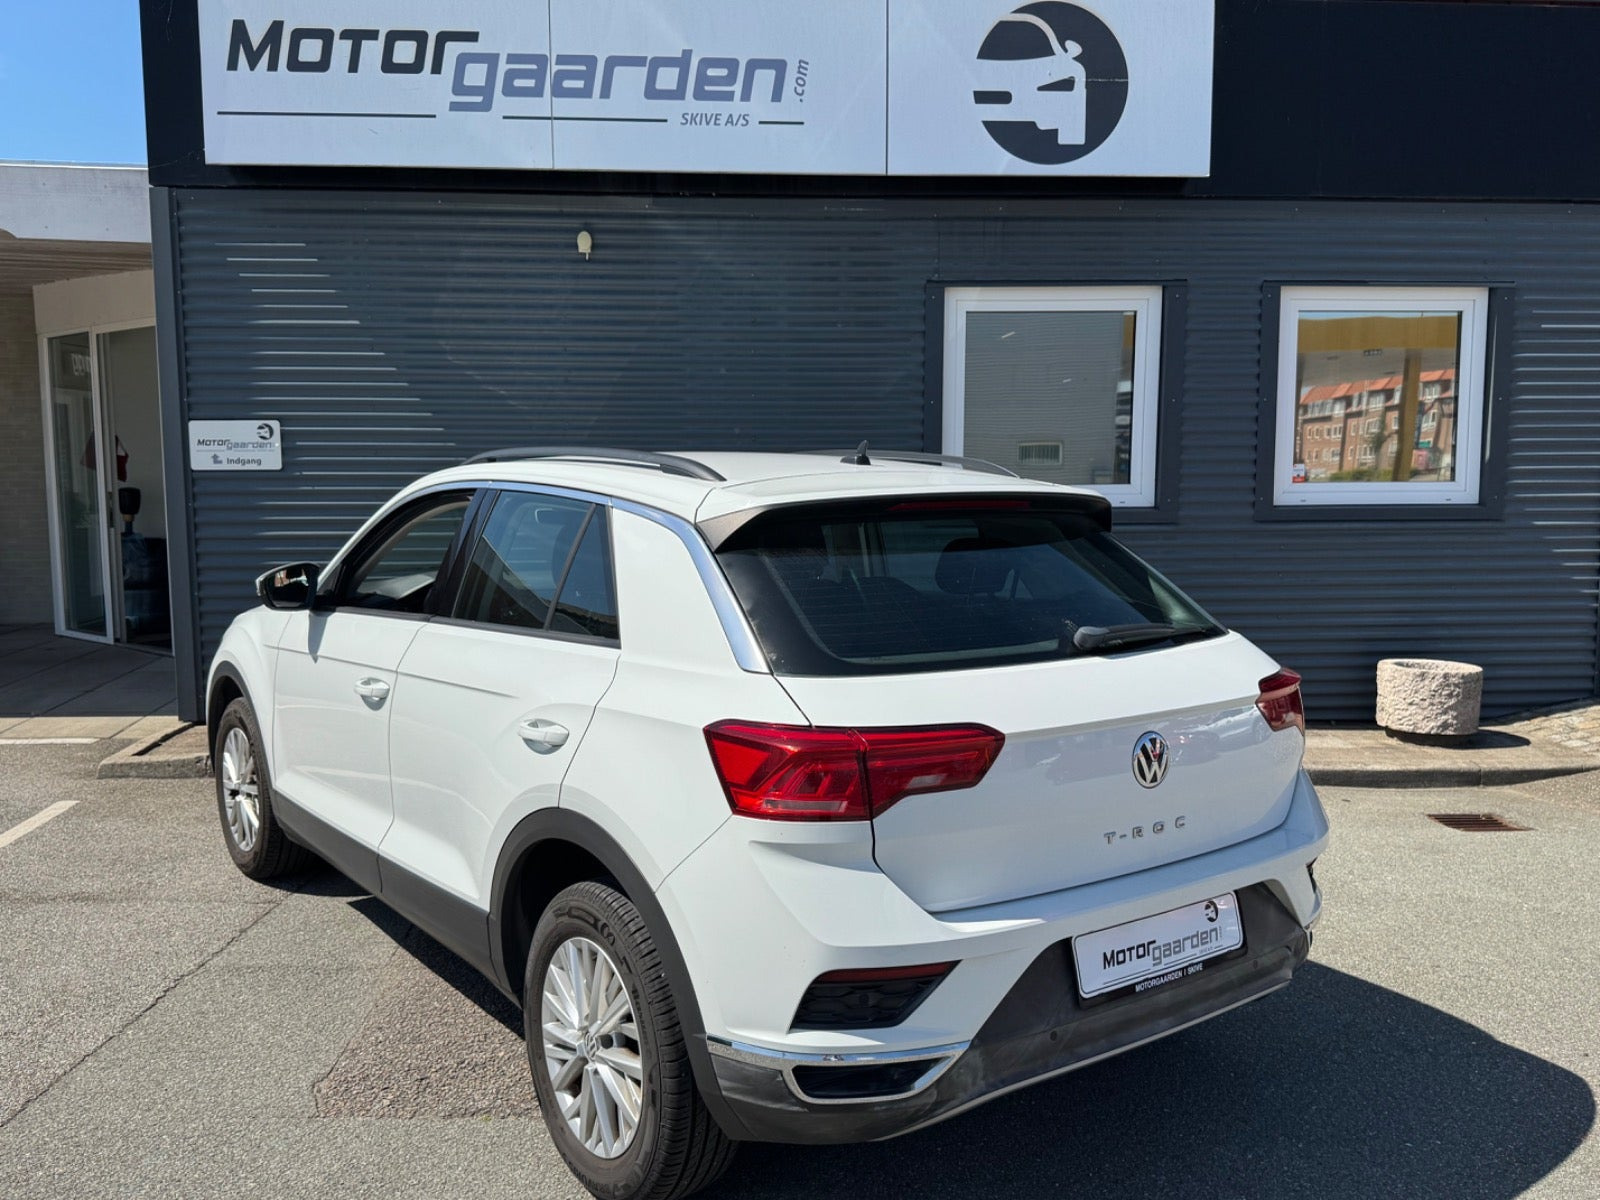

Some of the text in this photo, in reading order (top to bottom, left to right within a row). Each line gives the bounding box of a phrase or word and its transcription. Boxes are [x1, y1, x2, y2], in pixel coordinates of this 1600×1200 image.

[794, 59, 810, 103] .com
[680, 112, 750, 127] SKIVE A/S
[226, 457, 262, 466] Indgang
[1132, 731, 1169, 788] VW
[1103, 815, 1186, 844] T-ROC
[1135, 970, 1183, 992] MOTORGAARDEN
[1187, 963, 1204, 976] SKIVE
